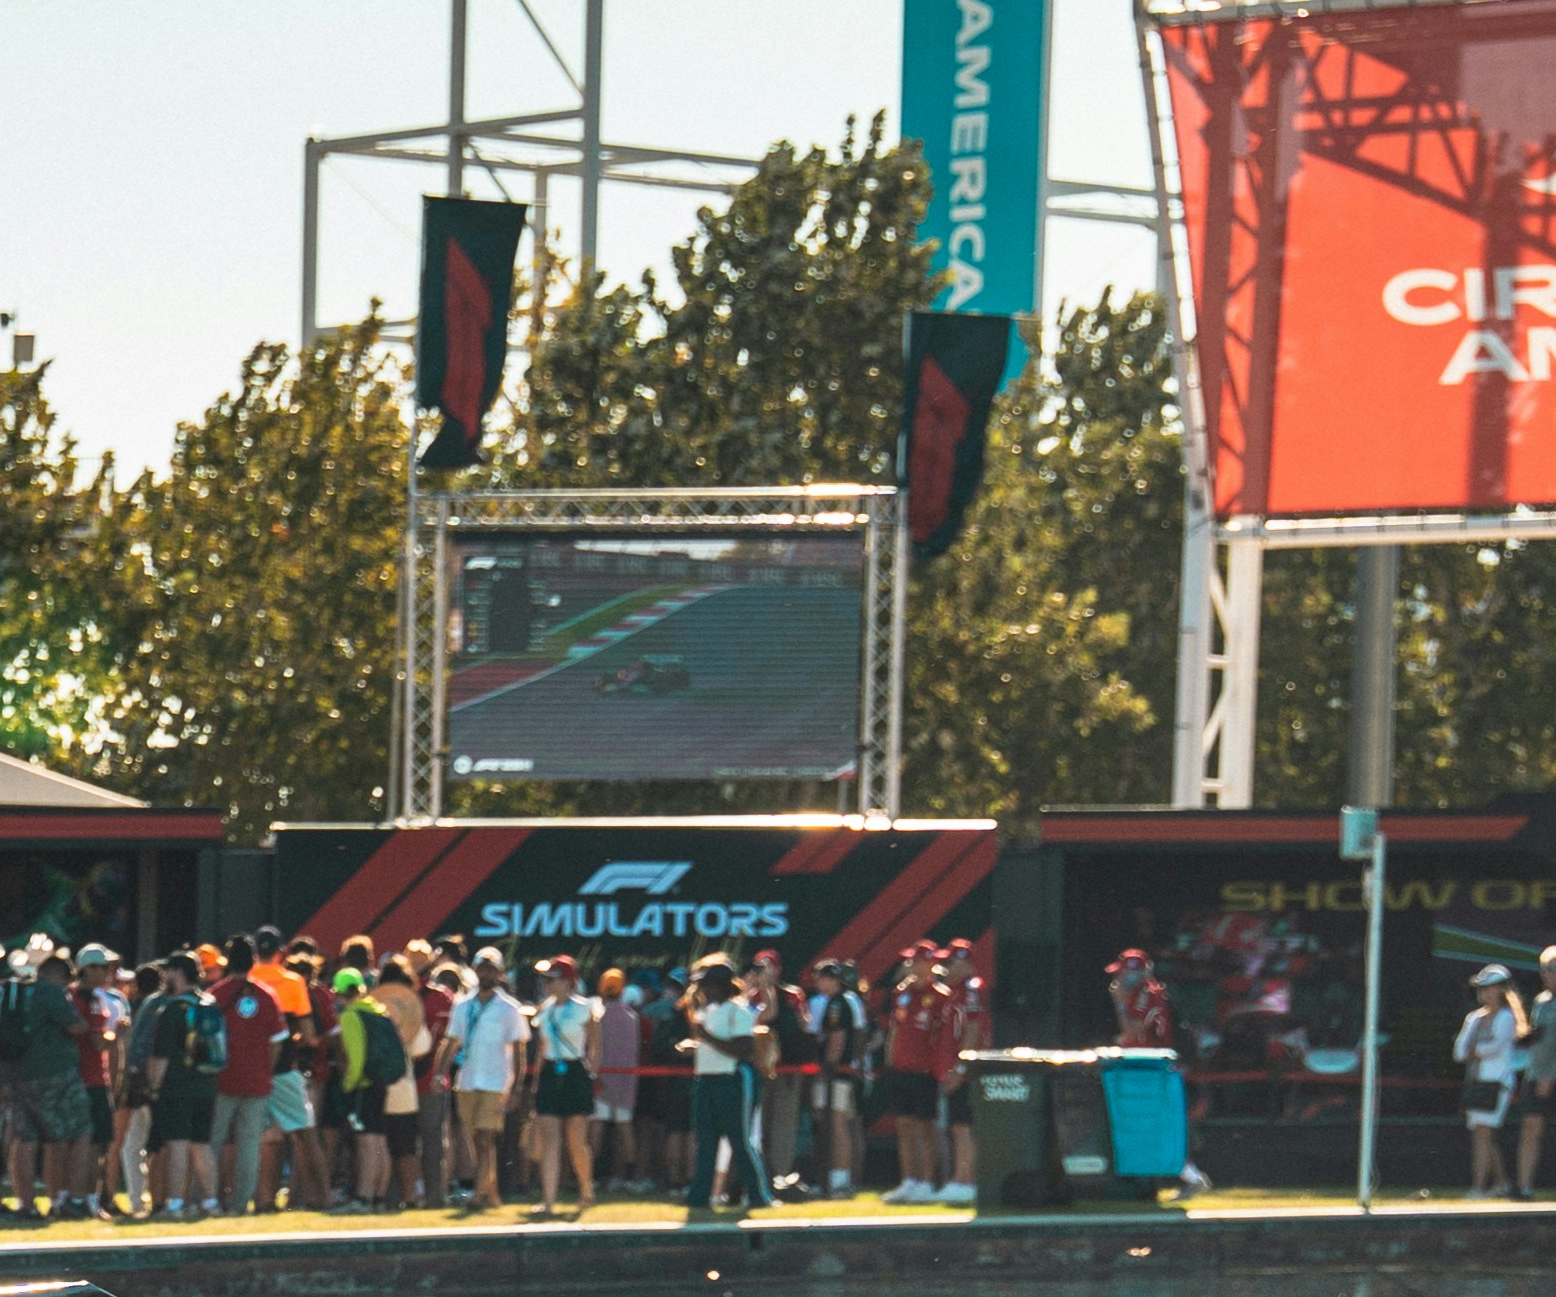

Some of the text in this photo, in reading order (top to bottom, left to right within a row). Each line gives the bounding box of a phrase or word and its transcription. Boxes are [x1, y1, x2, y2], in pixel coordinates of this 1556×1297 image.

[946, 0, 993, 314] AMERICA
[576, 860, 694, 896] F1
[1219, 880, 1456, 912] SHOW
[473, 901, 790, 938] SIMULATORS
